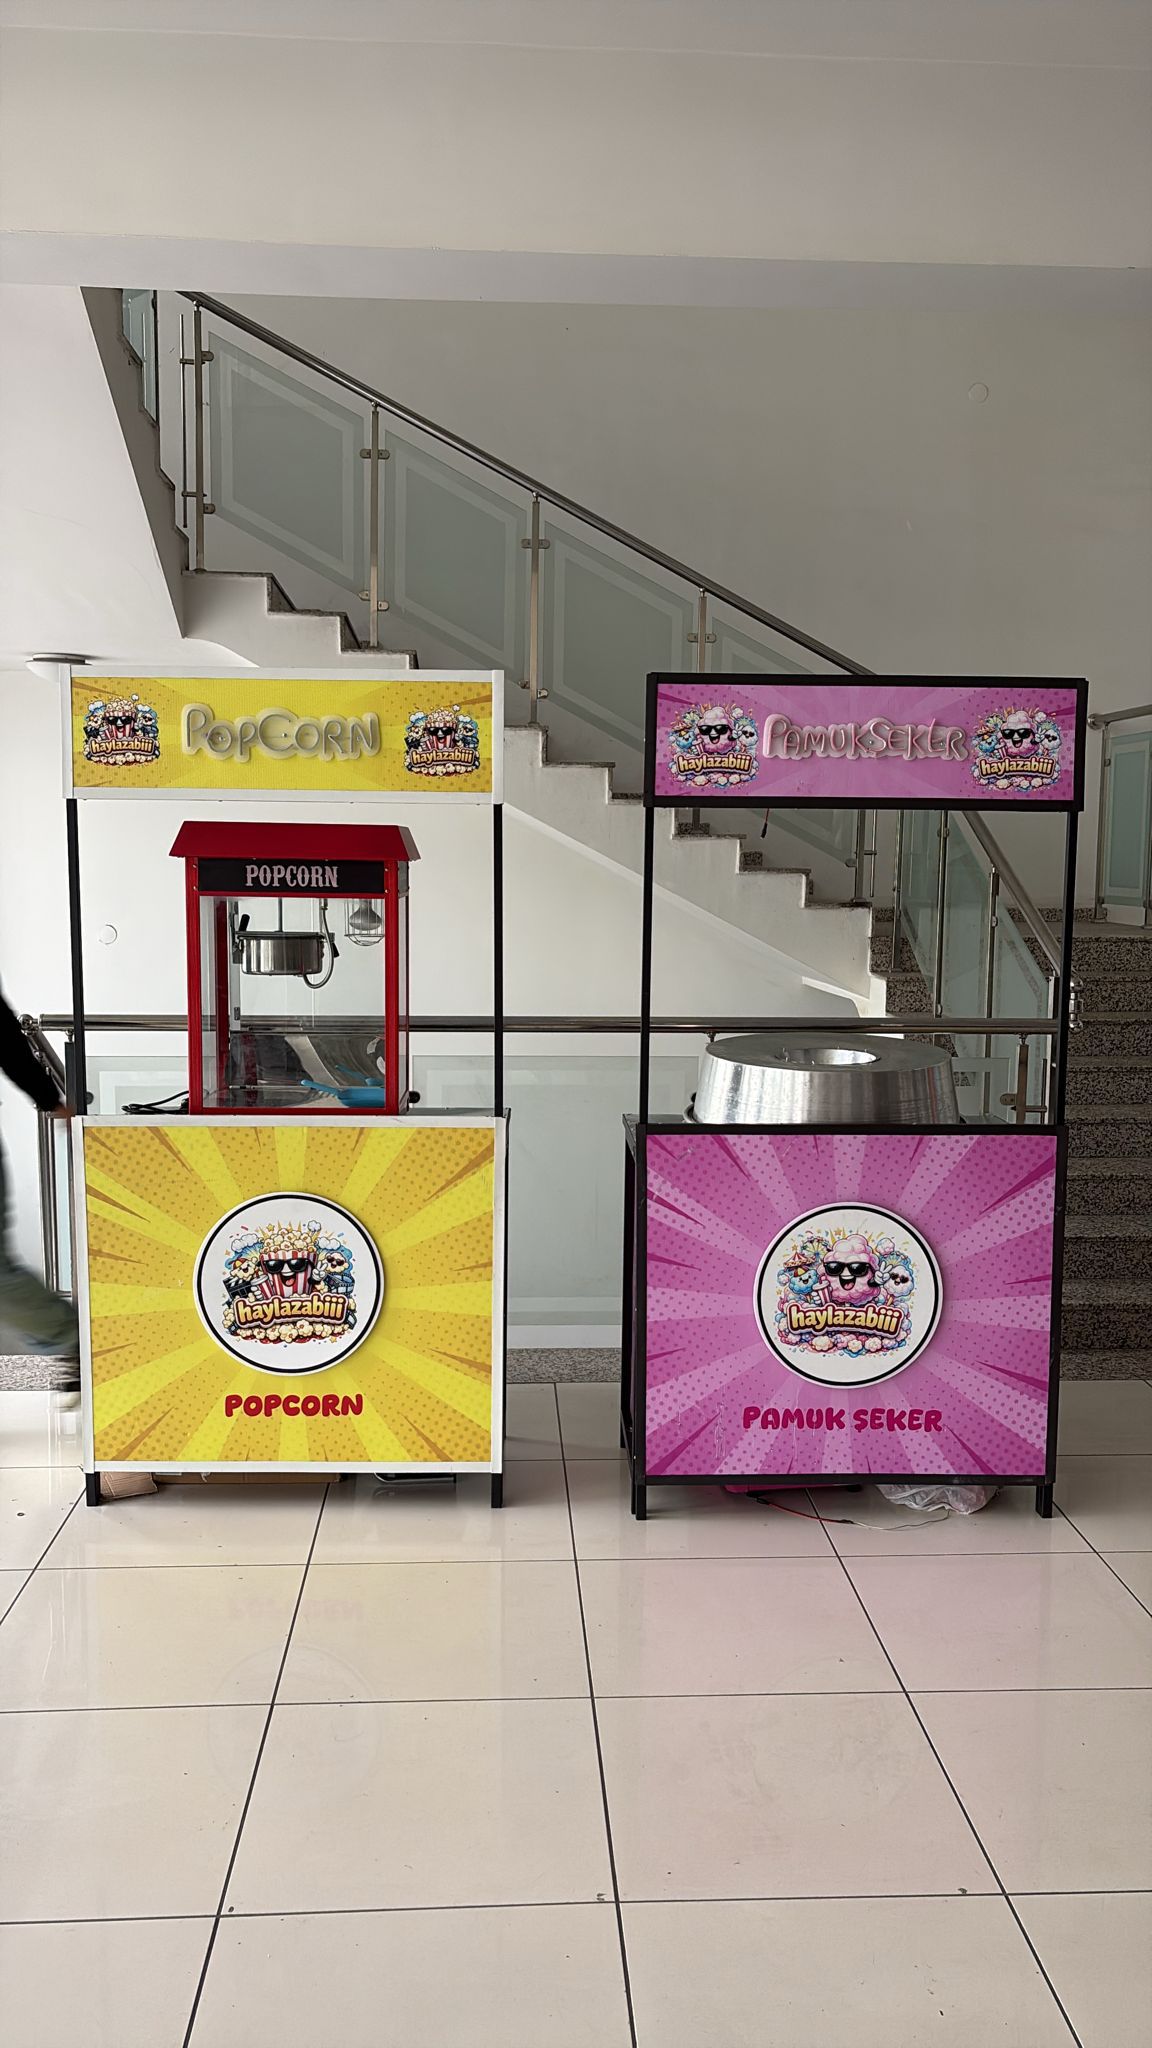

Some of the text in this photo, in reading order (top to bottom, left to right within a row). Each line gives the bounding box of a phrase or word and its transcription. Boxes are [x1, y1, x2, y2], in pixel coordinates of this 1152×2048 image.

[91, 738, 154, 754] haylazabiii
[412, 749, 474, 766] haylazabiii
[679, 753, 751, 772] haylazabiii
[980, 759, 1053, 776] haylazabiii
[245, 864, 339, 888] POPCORN
[238, 1295, 344, 1323] haylazabiii
[791, 1304, 900, 1332] haylazabiii
[224, 1394, 363, 1417] POPCORN
[743, 1406, 943, 1432] PAMUK ŞEKER
